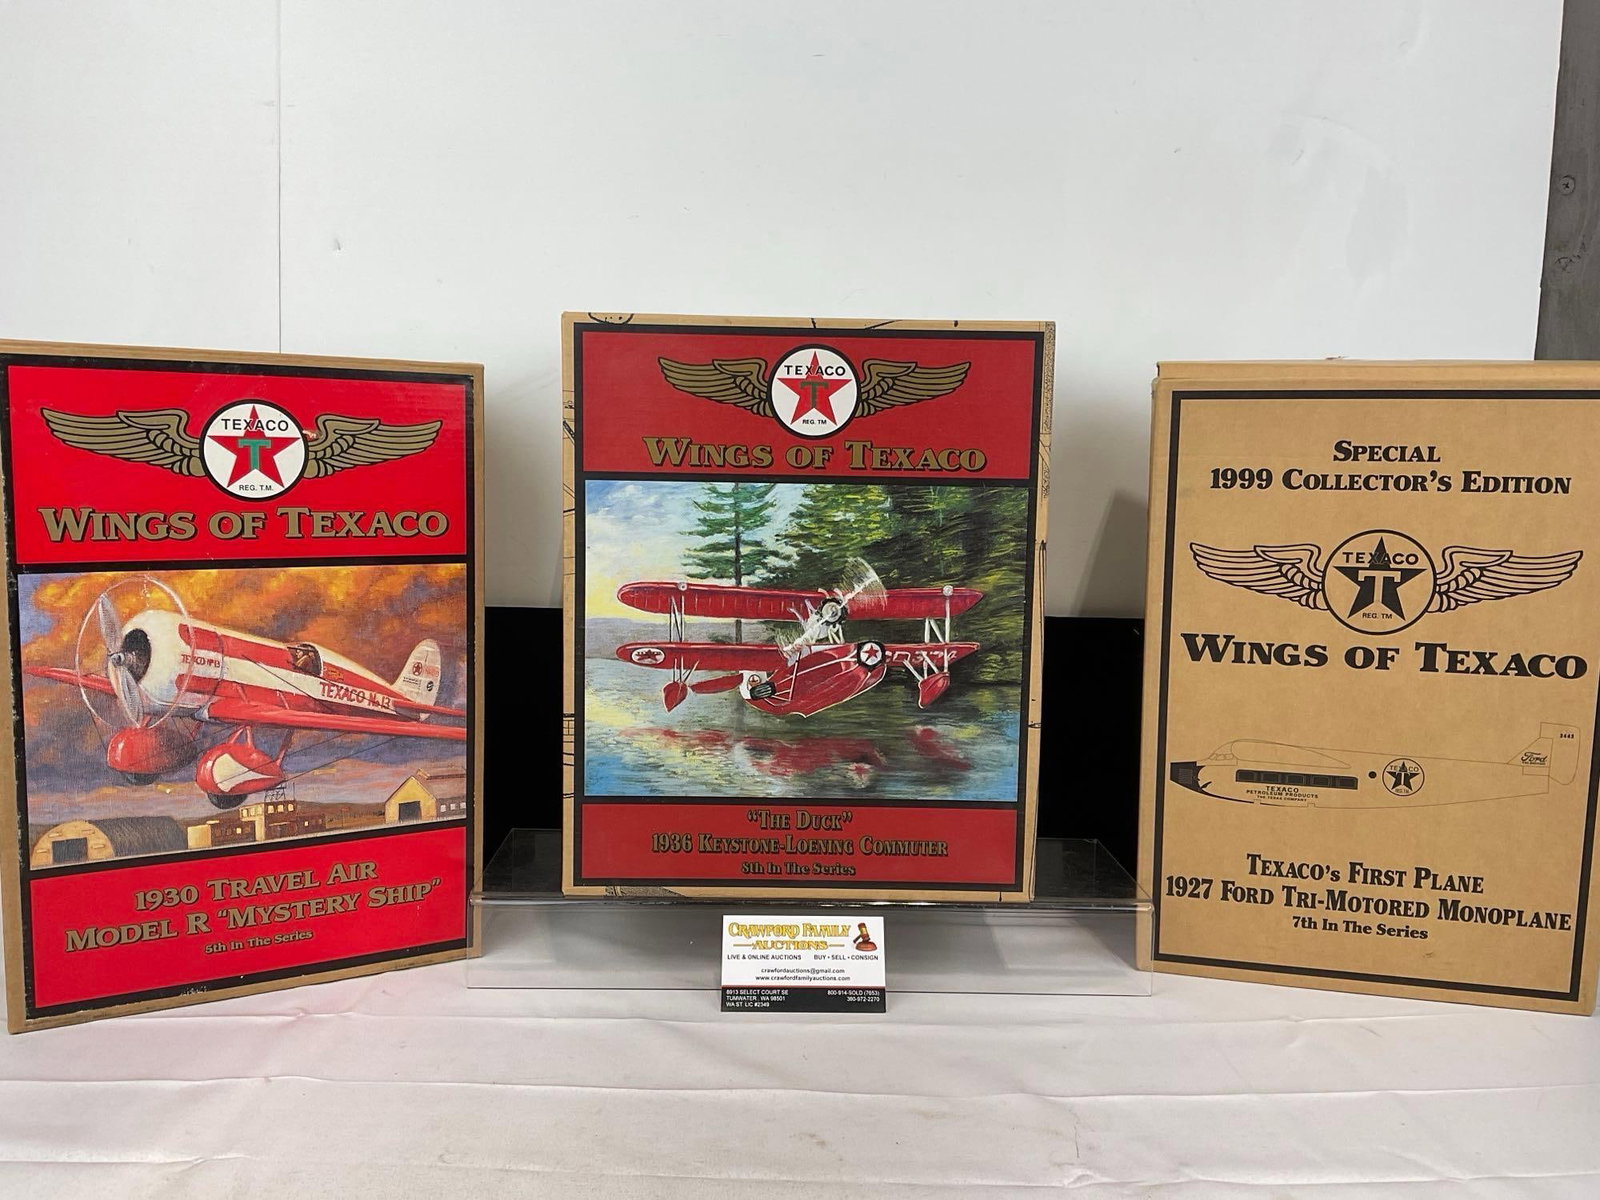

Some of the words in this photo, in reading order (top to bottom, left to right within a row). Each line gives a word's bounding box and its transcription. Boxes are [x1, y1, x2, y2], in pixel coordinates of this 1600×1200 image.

[785, 364, 846, 377] TEXACO
[801, 381, 829, 409] T
[221, 417, 289, 433] TEXACO
[238, 439, 271, 471] T
[643, 436, 773, 469] WINGS
[785, 445, 834, 468] OF
[844, 440, 987, 472] TEXACO
[1333, 440, 1441, 462] SPECIAL
[259, 484, 274, 492] T.M.
[1210, 468, 1273, 490] 1999
[1282, 468, 1452, 493] COLLECTOR'S
[1461, 471, 1572, 494] EDITION
[38, 507, 197, 543] WINGS
[208, 511, 267, 539] OF
[277, 506, 449, 538] TEXACO
[1342, 551, 1419, 565] TEXACO
[1358, 570, 1401, 602] T
[1180, 632, 1328, 668] WINGS
[1344, 646, 1401, 671] OF
[1415, 641, 1588, 680] TEXACO
[320, 682, 366, 704] TEXACO
[1520, 751, 1548, 763] Ford
[1265, 785, 1299, 793] TEXACO
[652, 834, 693, 853] 1936
[698, 833, 854, 855] KEYSTONE-LOENING
[859, 836, 948, 857] COMMUTER
[742, 862, 765, 875] 8th
[768, 862, 782, 874] In
[785, 862, 809, 875] The
[813, 862, 856, 876] Series
[1246, 853, 1341, 882] TEXACO'S
[1348, 862, 1407, 888] FIRST
[1413, 867, 1484, 894] PLANE
[134, 886, 199, 912] 1930
[207, 870, 320, 901] TRAVEL
[327, 861, 379, 884] AIR
[1165, 875, 1213, 898] 1927
[1220, 880, 1274, 906] FORD
[1281, 885, 1430, 919] TRI-MOTORED
[1437, 899, 1572, 931] MONOPLANE
[65, 922, 179, 953] MODEL
[186, 912, 210, 934] R
[728, 922, 800, 939] CRAWFORD
[802, 922, 851, 938] FAMILY
[1292, 916, 1319, 931] 7th
[1322, 918, 1339, 932] In
[1343, 920, 1372, 935] The
[1376, 923, 1429, 940] Series
[204, 942, 227, 955] 5th
[230, 939, 244, 951] In
[247, 935, 271, 949] The
[274, 930, 313, 946] Series
[752, 940, 829, 951] AUCTIONS
